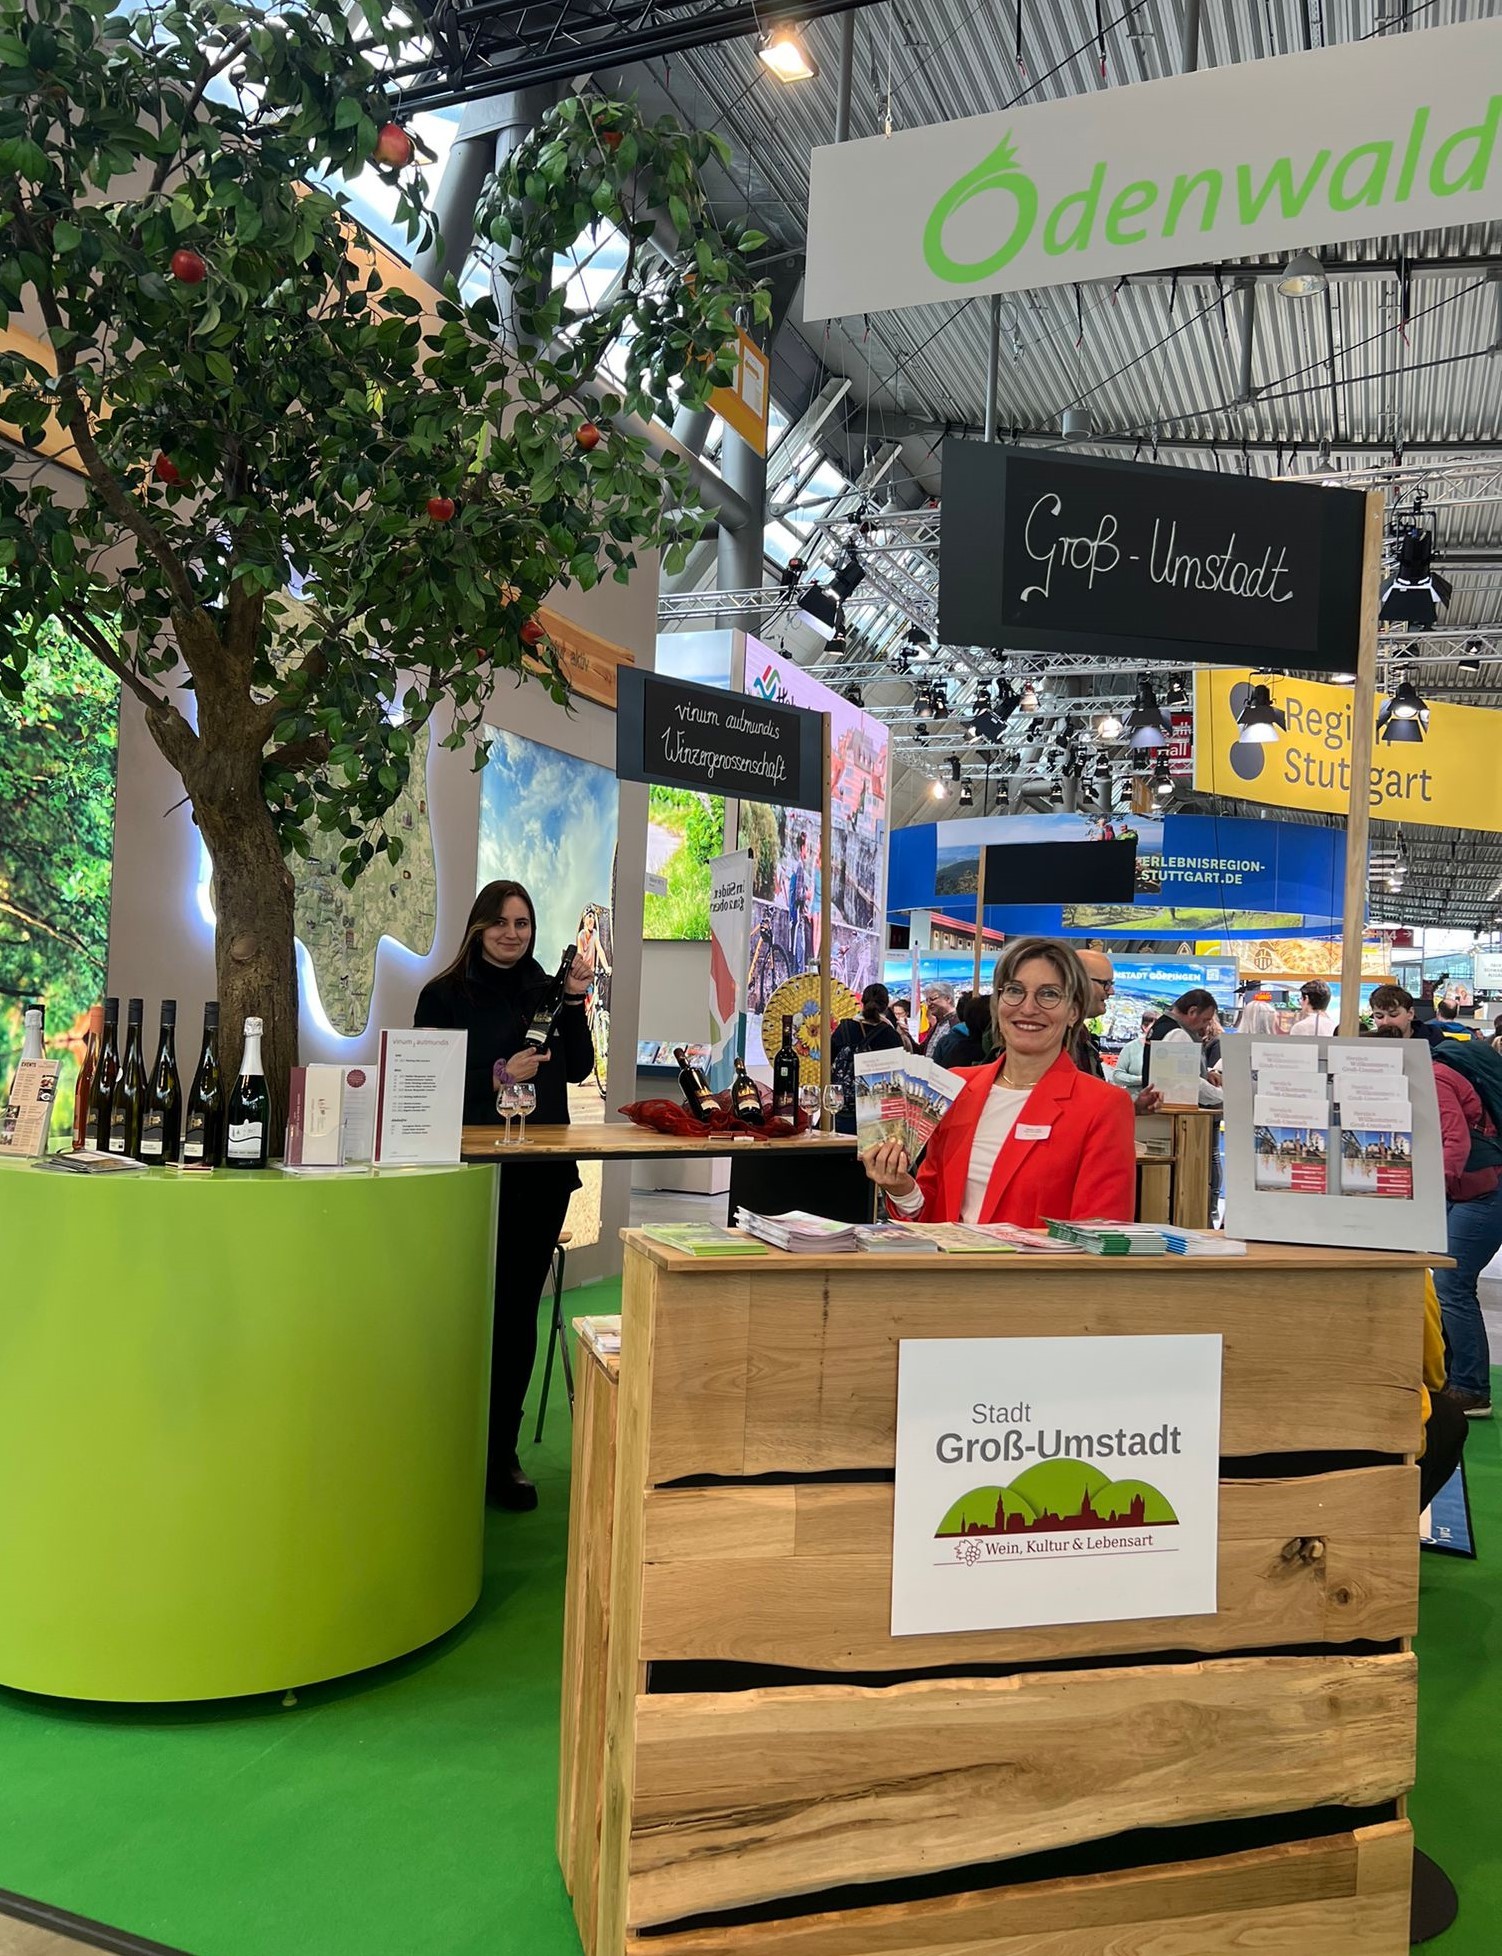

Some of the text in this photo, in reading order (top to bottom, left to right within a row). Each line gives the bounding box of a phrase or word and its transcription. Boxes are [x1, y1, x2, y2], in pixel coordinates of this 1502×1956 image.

[922, 94, 1502, 284] Odenwald
[674, 701, 780, 740] vinum autmundis
[661, 727, 787, 787] Winzergenossenschaft
[1284, 748, 1432, 806] Stutgart
[1141, 856, 1265, 872] ERLEBNISREGION-
[1141, 870, 1243, 885] STUTTGART.DE
[1149, 971, 1201, 982] GÖPPINGEN
[972, 1401, 1032, 1424] Stadt
[936, 1424, 1182, 1464] Groß-Umstadt
[985, 1534, 1154, 1555] Wein, Kultur & Lebensart
